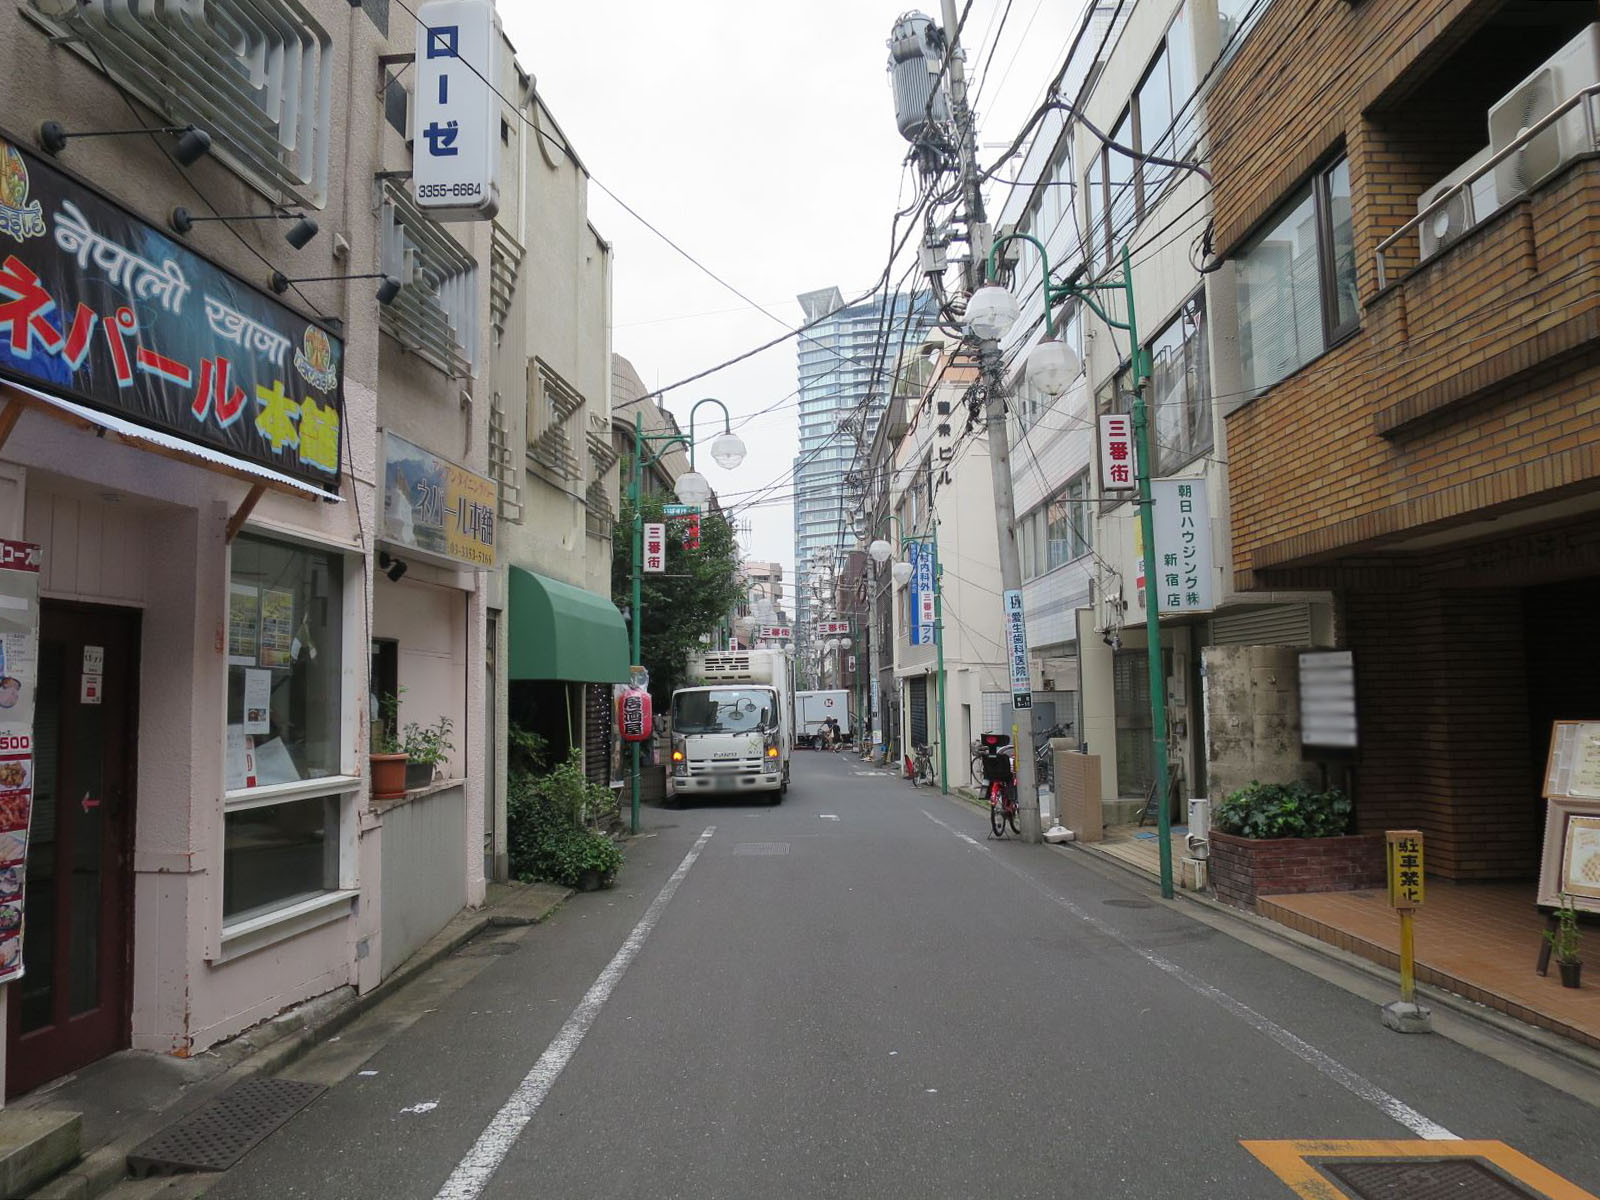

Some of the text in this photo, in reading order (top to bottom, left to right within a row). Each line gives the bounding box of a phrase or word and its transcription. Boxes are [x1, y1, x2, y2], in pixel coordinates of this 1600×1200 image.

[423, 25, 459, 157] ローゼ
[418, 182, 482, 198] 3355-6664
[53, 199, 192, 315] नेपाली
[203, 295, 292, 368] खाजा
[1109, 420, 1129, 482] 三番街
[648, 527, 661, 568] 三番街
[1164, 553, 1181, 606] 新宿店
[923, 593, 932, 620] 三番街
[762, 627, 790, 637] 三番街
[819, 623, 848, 632] 三番街
[624, 696, 643, 736] 居酒屋
[0, 736, 29, 750] 500
[1398, 838, 1419, 903] 駐車禁止
